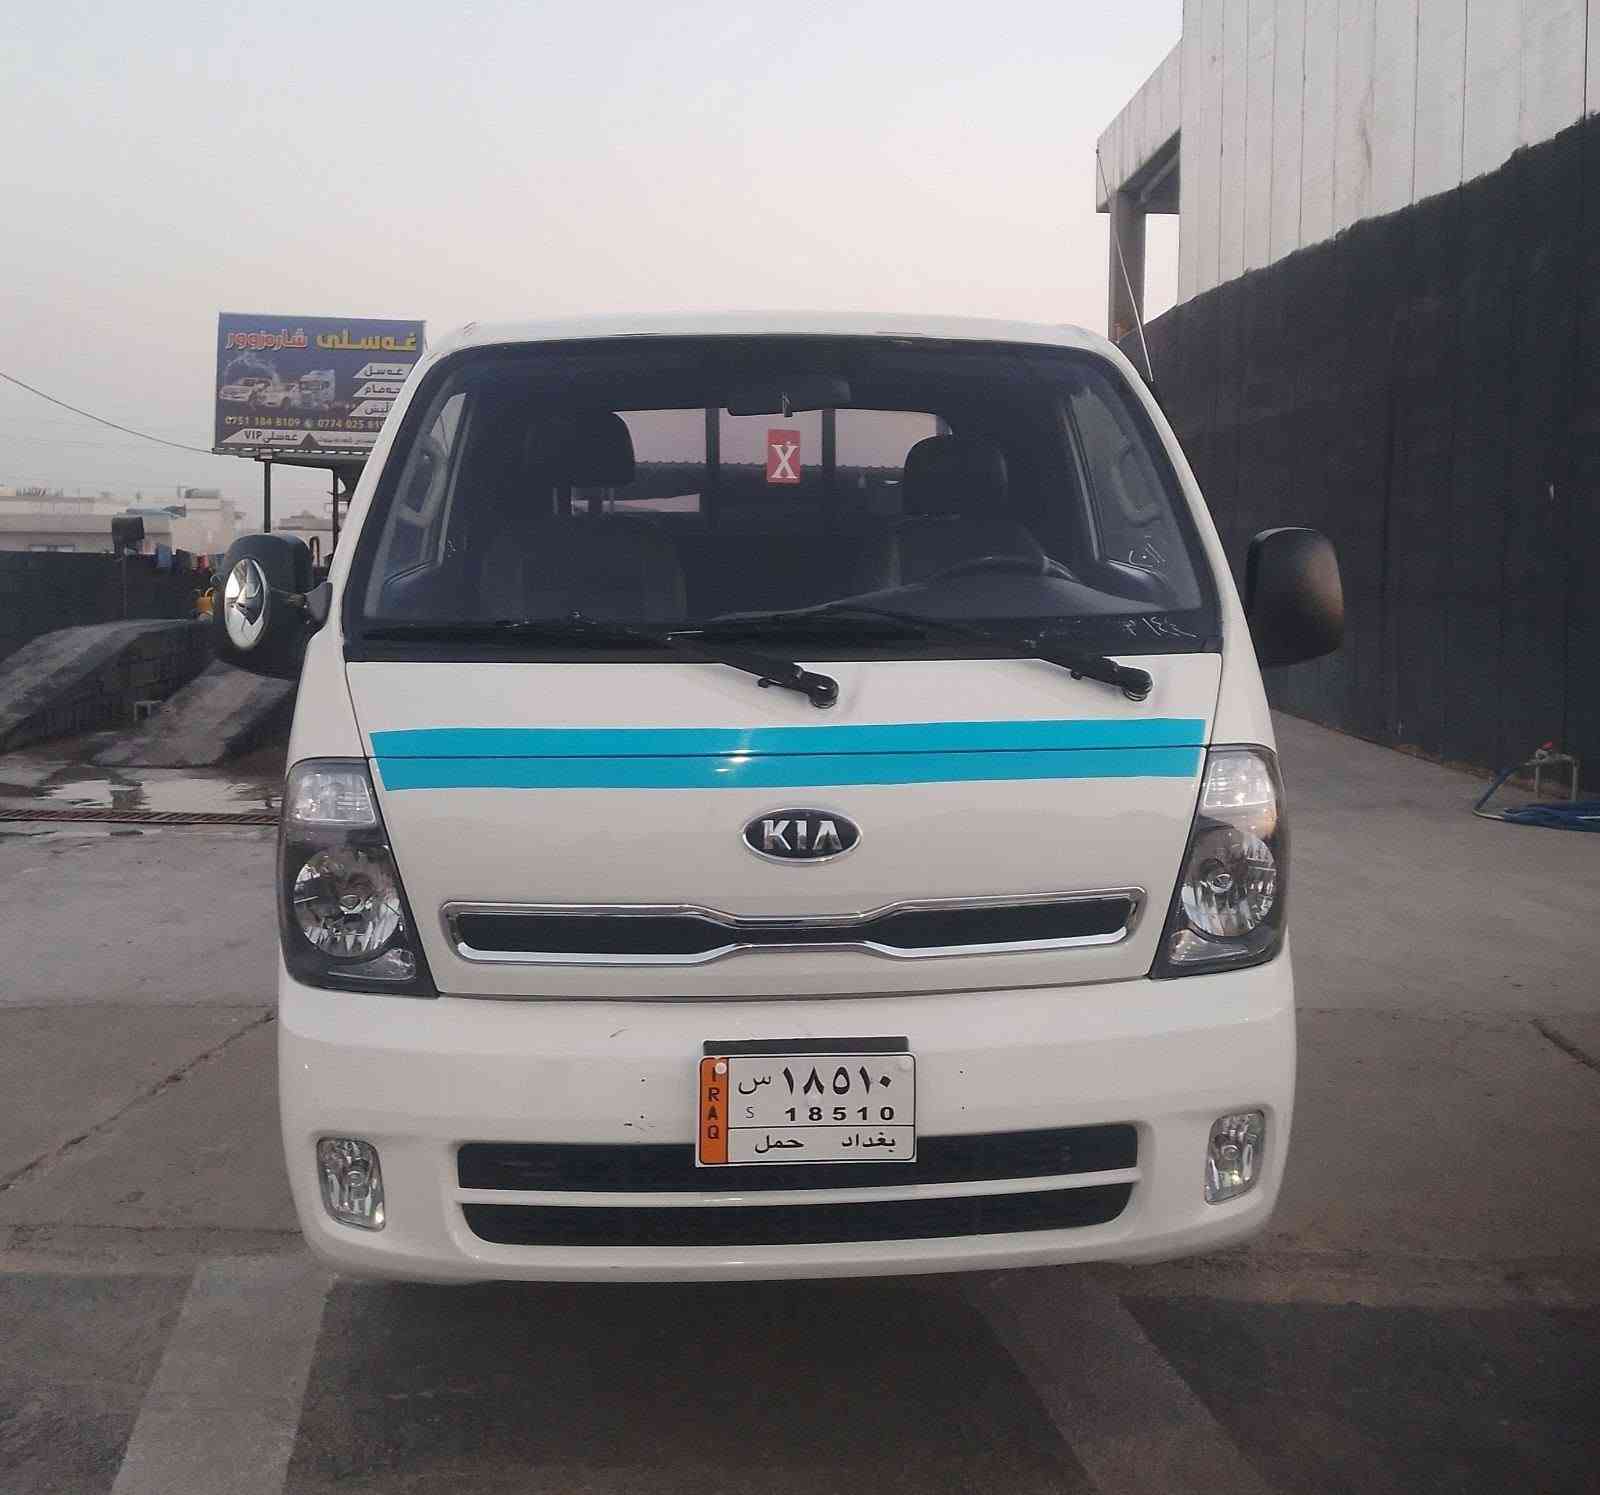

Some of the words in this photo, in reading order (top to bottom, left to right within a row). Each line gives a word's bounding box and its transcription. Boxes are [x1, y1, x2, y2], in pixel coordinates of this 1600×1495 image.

[243, 430, 262, 440] VIP
[761, 819, 844, 851] KIA
[782, 1065, 893, 1096] ١٨٥١٠
[707, 1066, 720, 1140] IRAQ
[744, 1105, 755, 1120] S
[784, 1106, 896, 1123] 18510
[754, 1134, 805, 1154] حمل
[840, 1131, 897, 1153] بغداد
